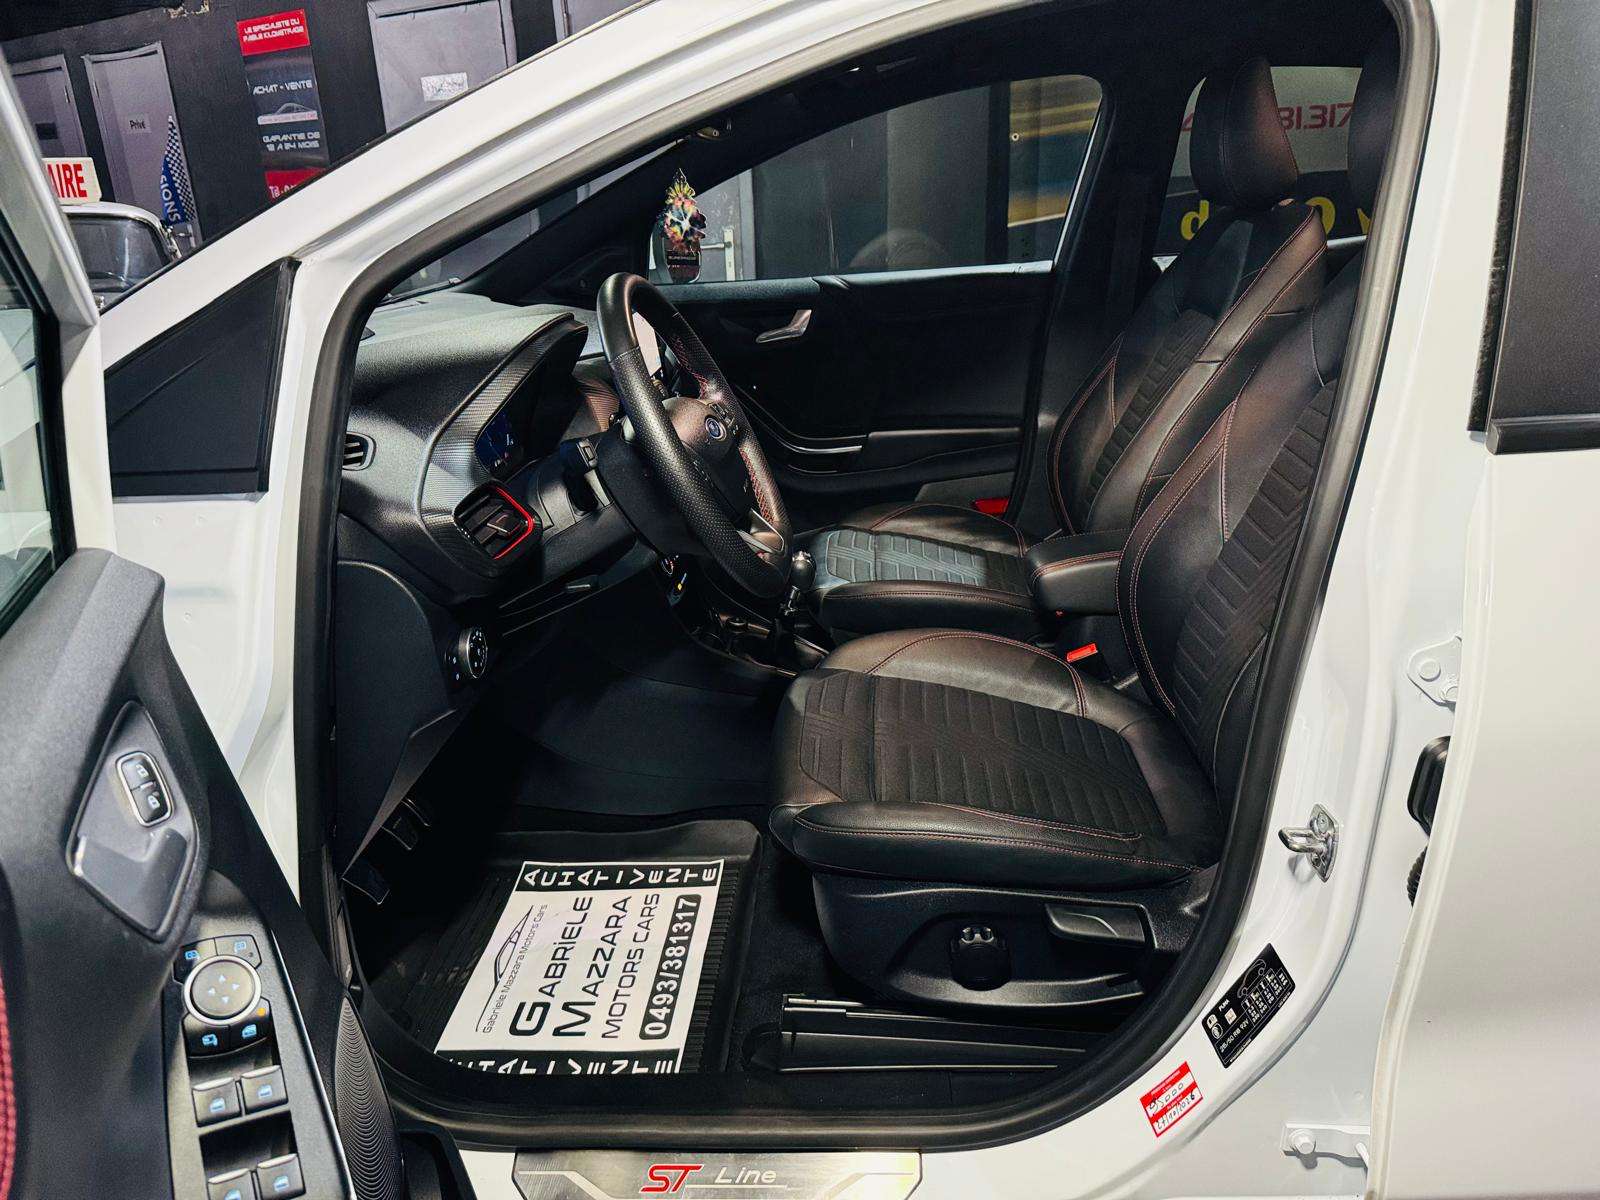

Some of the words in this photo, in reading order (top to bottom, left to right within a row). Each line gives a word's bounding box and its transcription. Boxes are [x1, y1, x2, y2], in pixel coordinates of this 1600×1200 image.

[252, 84, 278, 95] ACHAT
[285, 79, 313, 91] VENTE
[160, 174, 182, 222] SIONS
[482, 993, 507, 1034] Gabriele
[500, 952, 525, 993] Mazzara
[552, 895, 632, 1037] MAZZARA
[601, 947, 645, 1039] MOTORS
[632, 893, 660, 943] CARS
[644, 898, 698, 1036] 0493/381317
[640, 1163, 704, 1194] ST
[714, 1166, 777, 1184] Line
